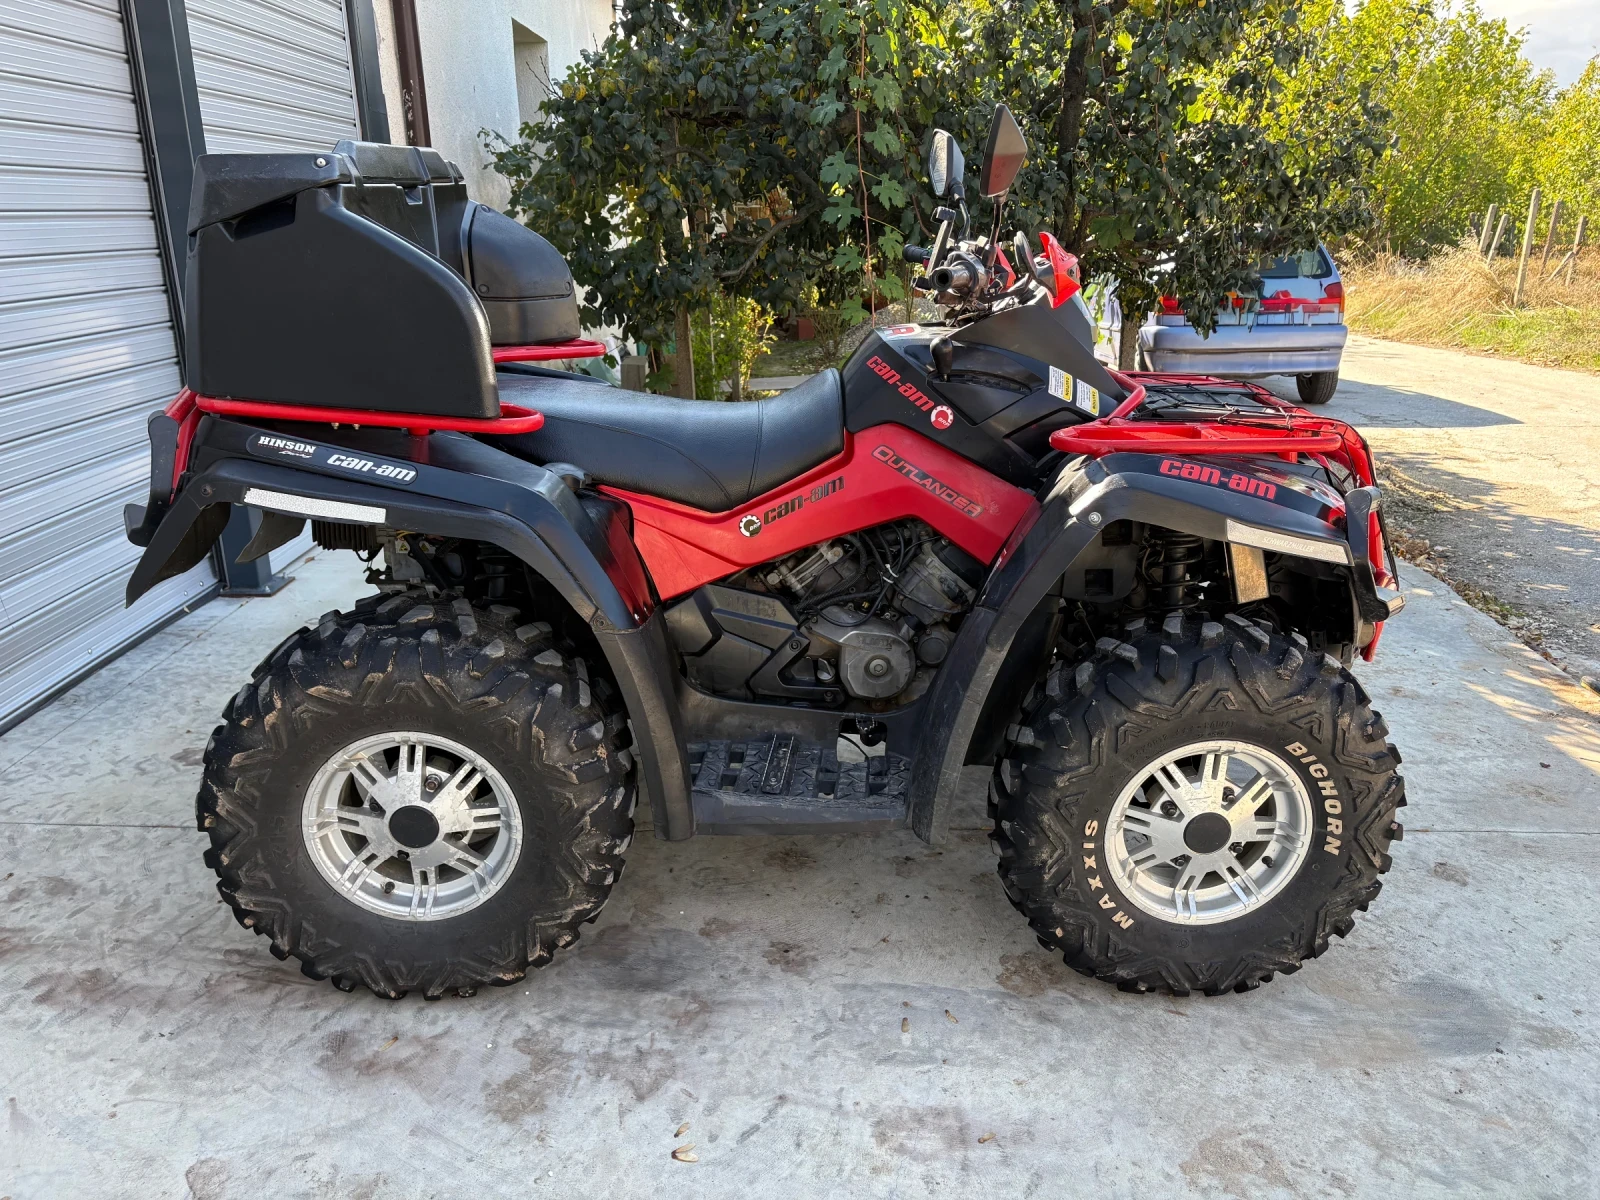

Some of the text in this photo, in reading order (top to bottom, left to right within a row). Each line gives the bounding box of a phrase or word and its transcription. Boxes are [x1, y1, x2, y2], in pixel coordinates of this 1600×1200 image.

[866, 355, 935, 412] can-am
[257, 435, 316, 454] HINSON
[327, 453, 417, 482] can-am
[763, 475, 845, 526] can-am
[870, 444, 984, 518] OUTLANDER
[1159, 459, 1277, 501] can-am
[1284, 741, 1343, 856] BIGHORN
[1083, 819, 1135, 930] MAXXIS
